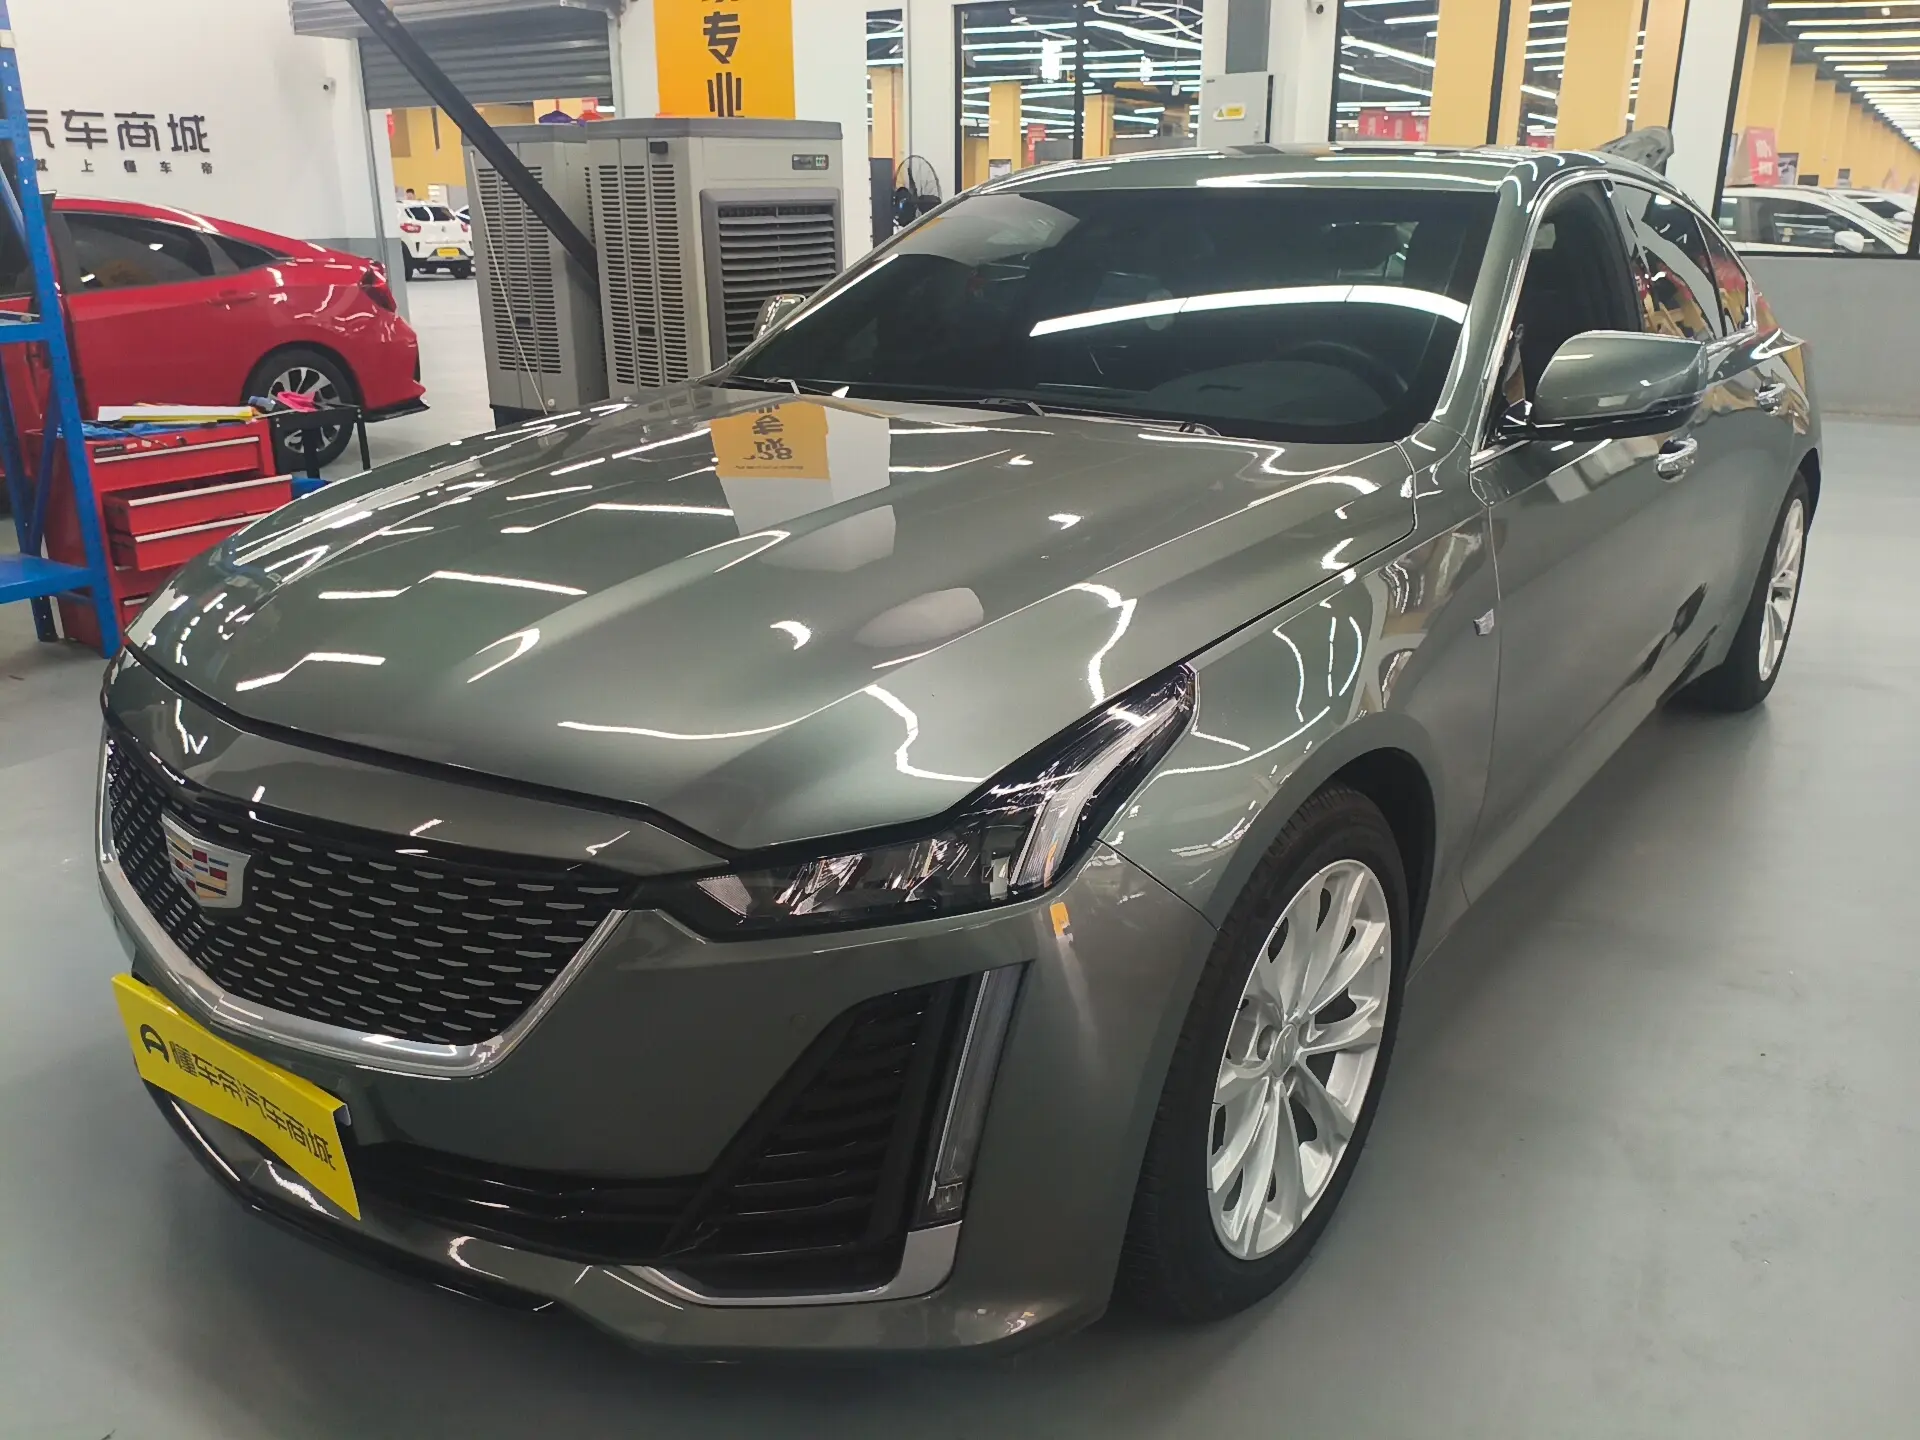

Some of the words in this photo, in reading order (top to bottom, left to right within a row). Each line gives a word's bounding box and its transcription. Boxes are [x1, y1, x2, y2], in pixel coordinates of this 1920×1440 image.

[702, 0, 745, 118] 专业
[168, 1041, 337, 1171] 懂车帝汽车商城
